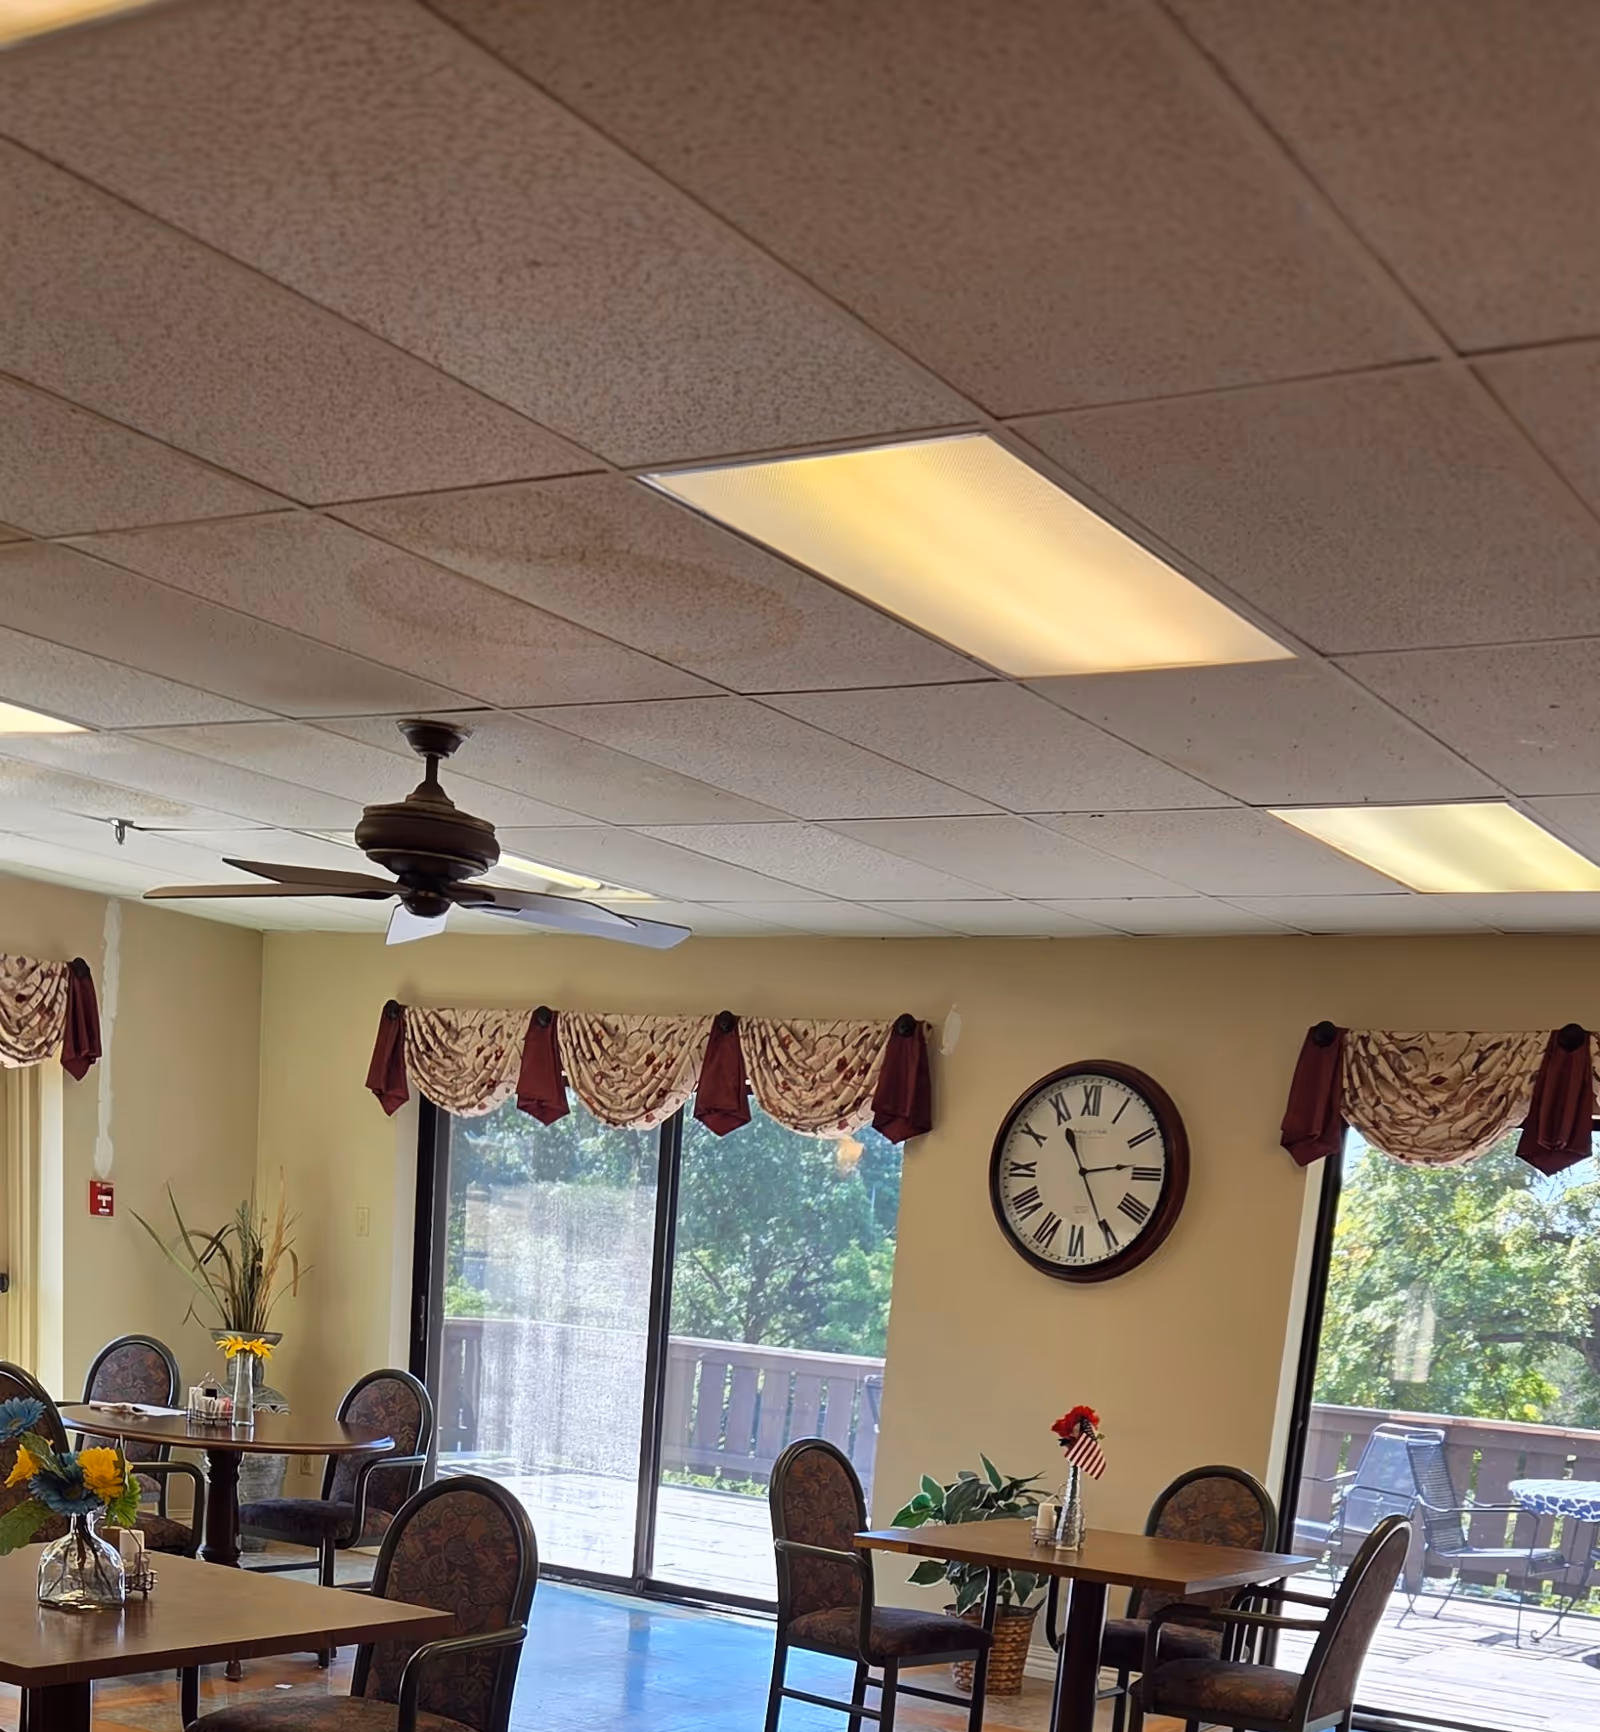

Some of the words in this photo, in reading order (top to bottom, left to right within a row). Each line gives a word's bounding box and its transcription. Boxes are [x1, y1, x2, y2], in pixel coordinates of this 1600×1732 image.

[1049, 1092, 1072, 1127] XI
[1080, 1085, 1102, 1117] XII
[1111, 1097, 1131, 1124] I
[1020, 1122, 1048, 1148] X
[1127, 1127, 1157, 1149] II
[1008, 1161, 1037, 1178] IX
[1131, 1167, 1162, 1181] III
[1012, 1185, 1044, 1222] VIII
[1117, 1192, 1151, 1226] IIII
[1032, 1211, 1062, 1249] VII
[1068, 1224, 1084, 1257] VI
[1098, 1218, 1119, 1251] V
